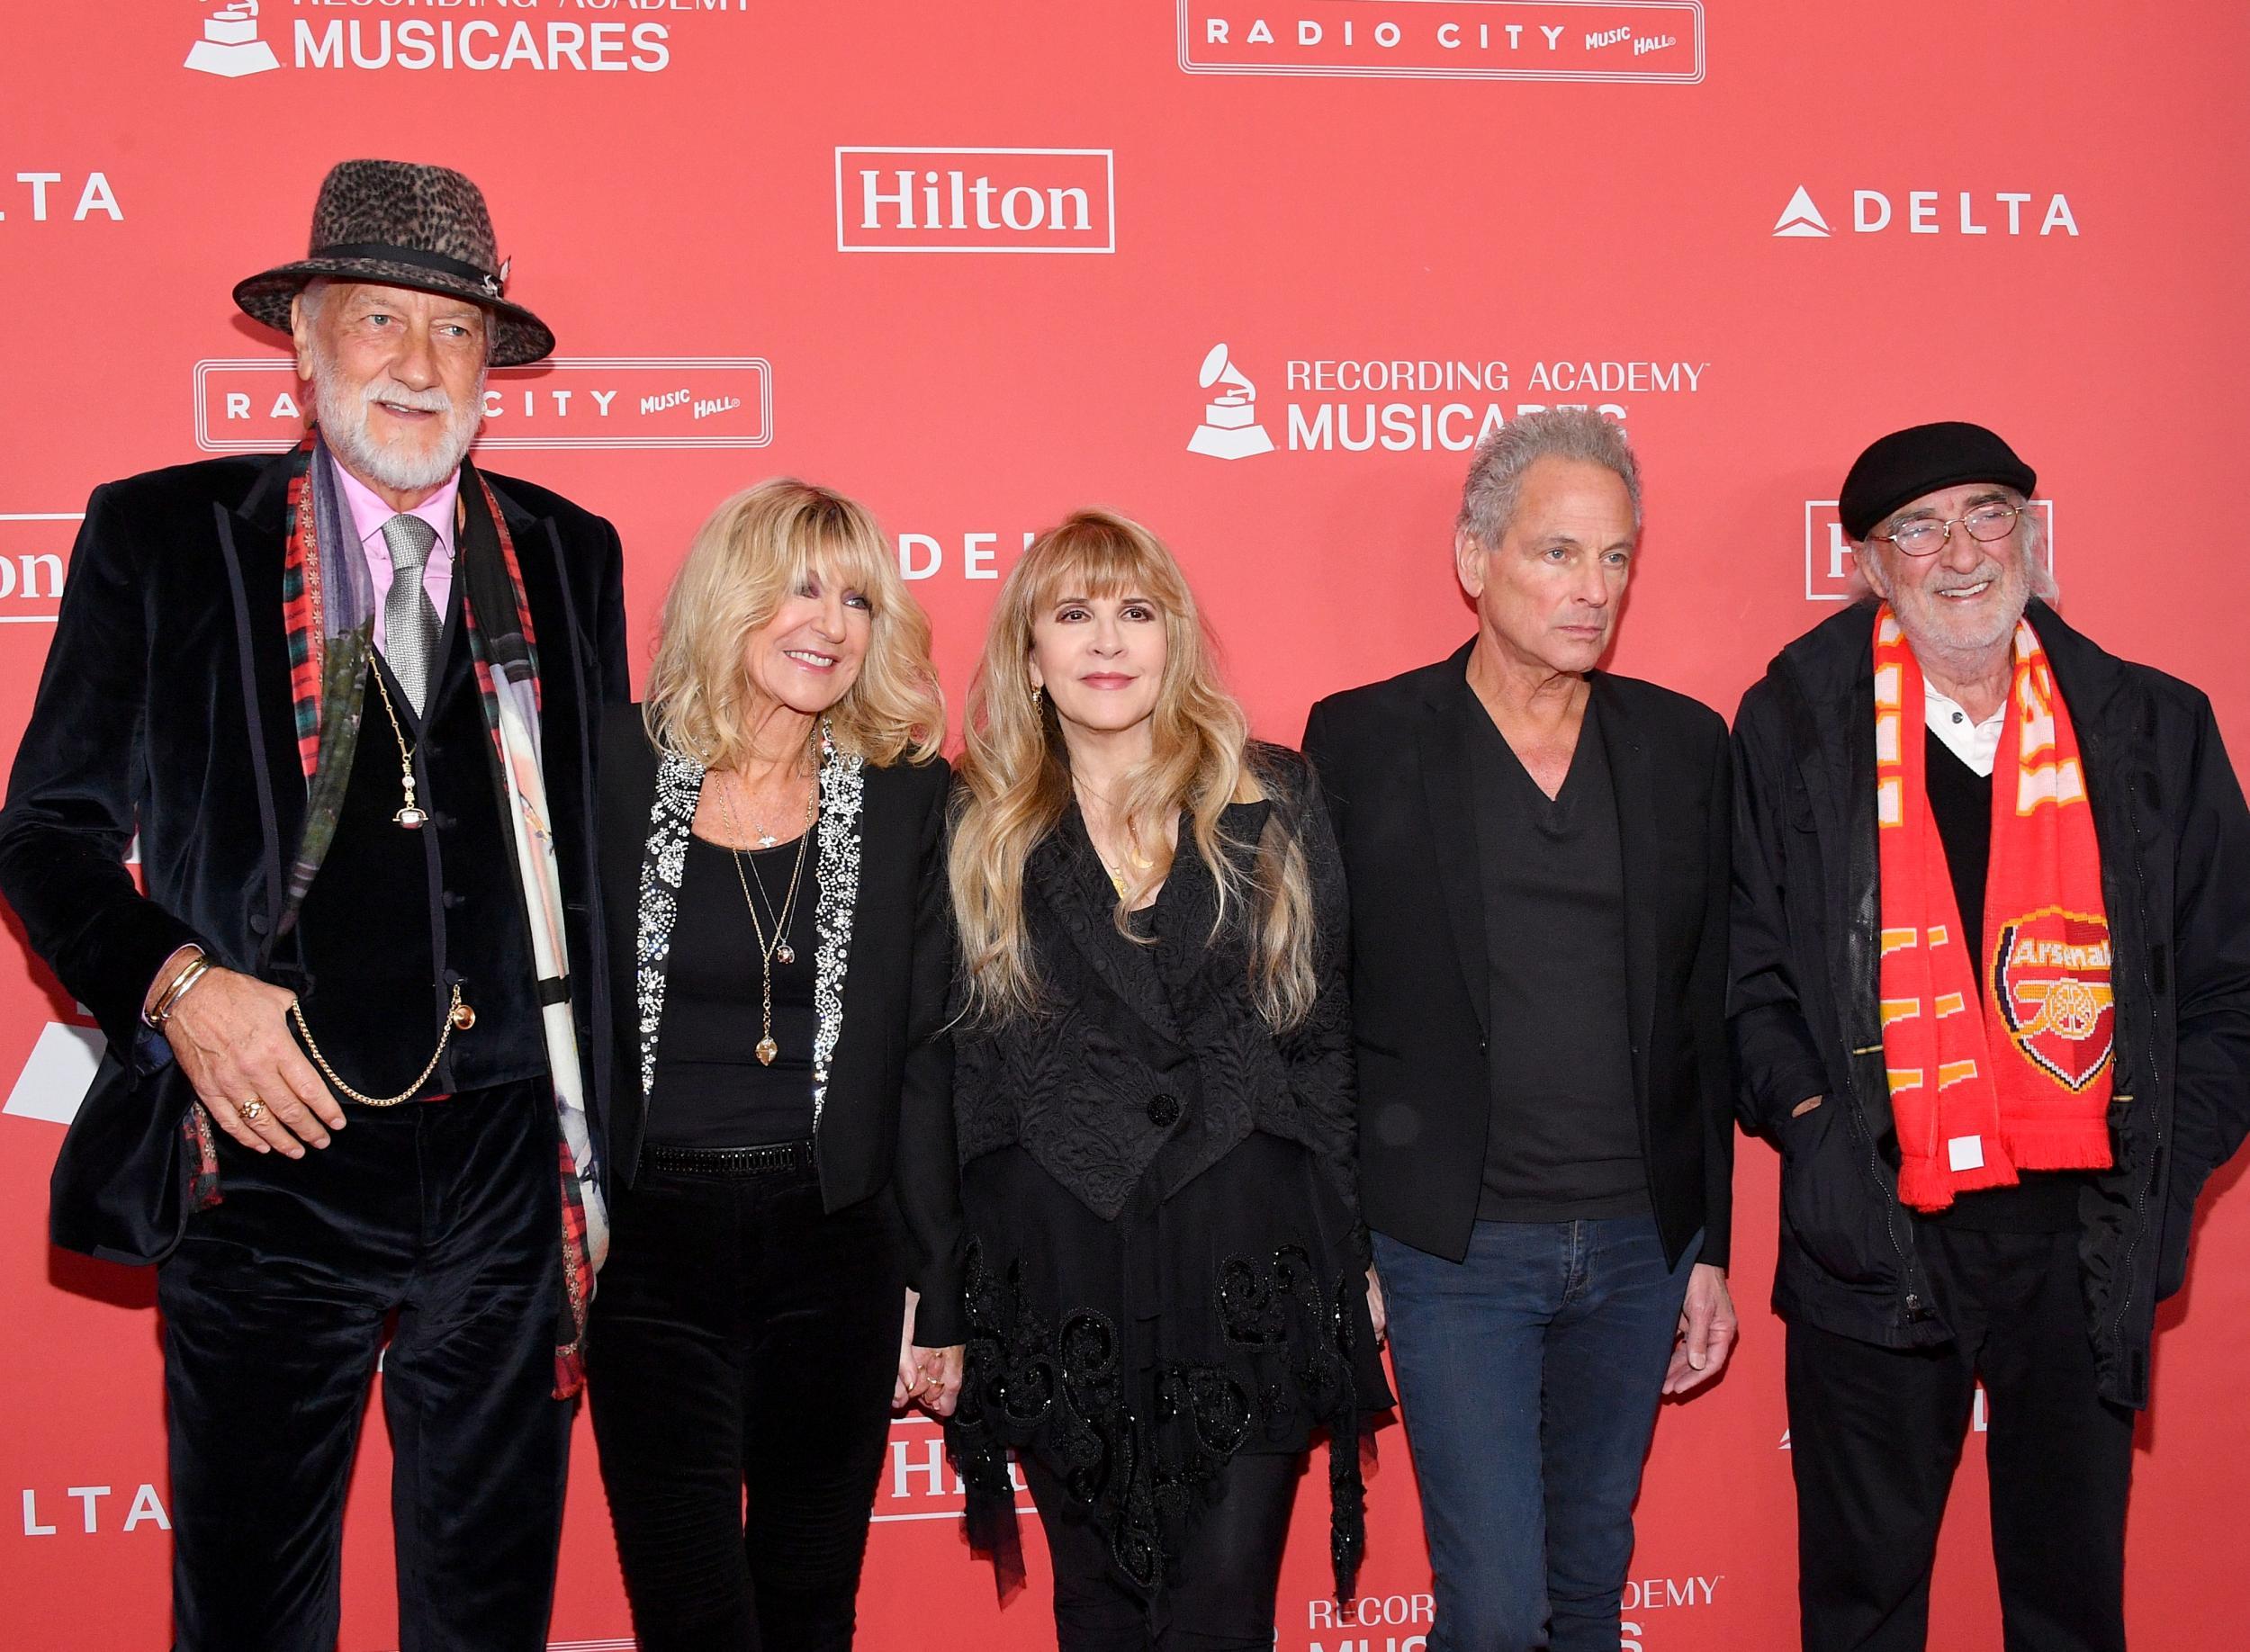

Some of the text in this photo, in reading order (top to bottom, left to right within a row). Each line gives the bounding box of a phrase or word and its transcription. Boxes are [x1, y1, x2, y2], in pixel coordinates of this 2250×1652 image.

[293, 20, 670, 72] MUSICARES
[1206, 18, 1401, 48] RADIO
[1436, 23, 1565, 50] CITY
[1585, 26, 1631, 50] MUSIC
[0, 172, 124, 221] TA
[859, 169, 1093, 231] Hilton
[1853, 190, 2080, 237] DELTA
[1286, 360, 1509, 391] RECORDING
[482, 390, 618, 418] CITY
[640, 389, 691, 416] MUSIC
